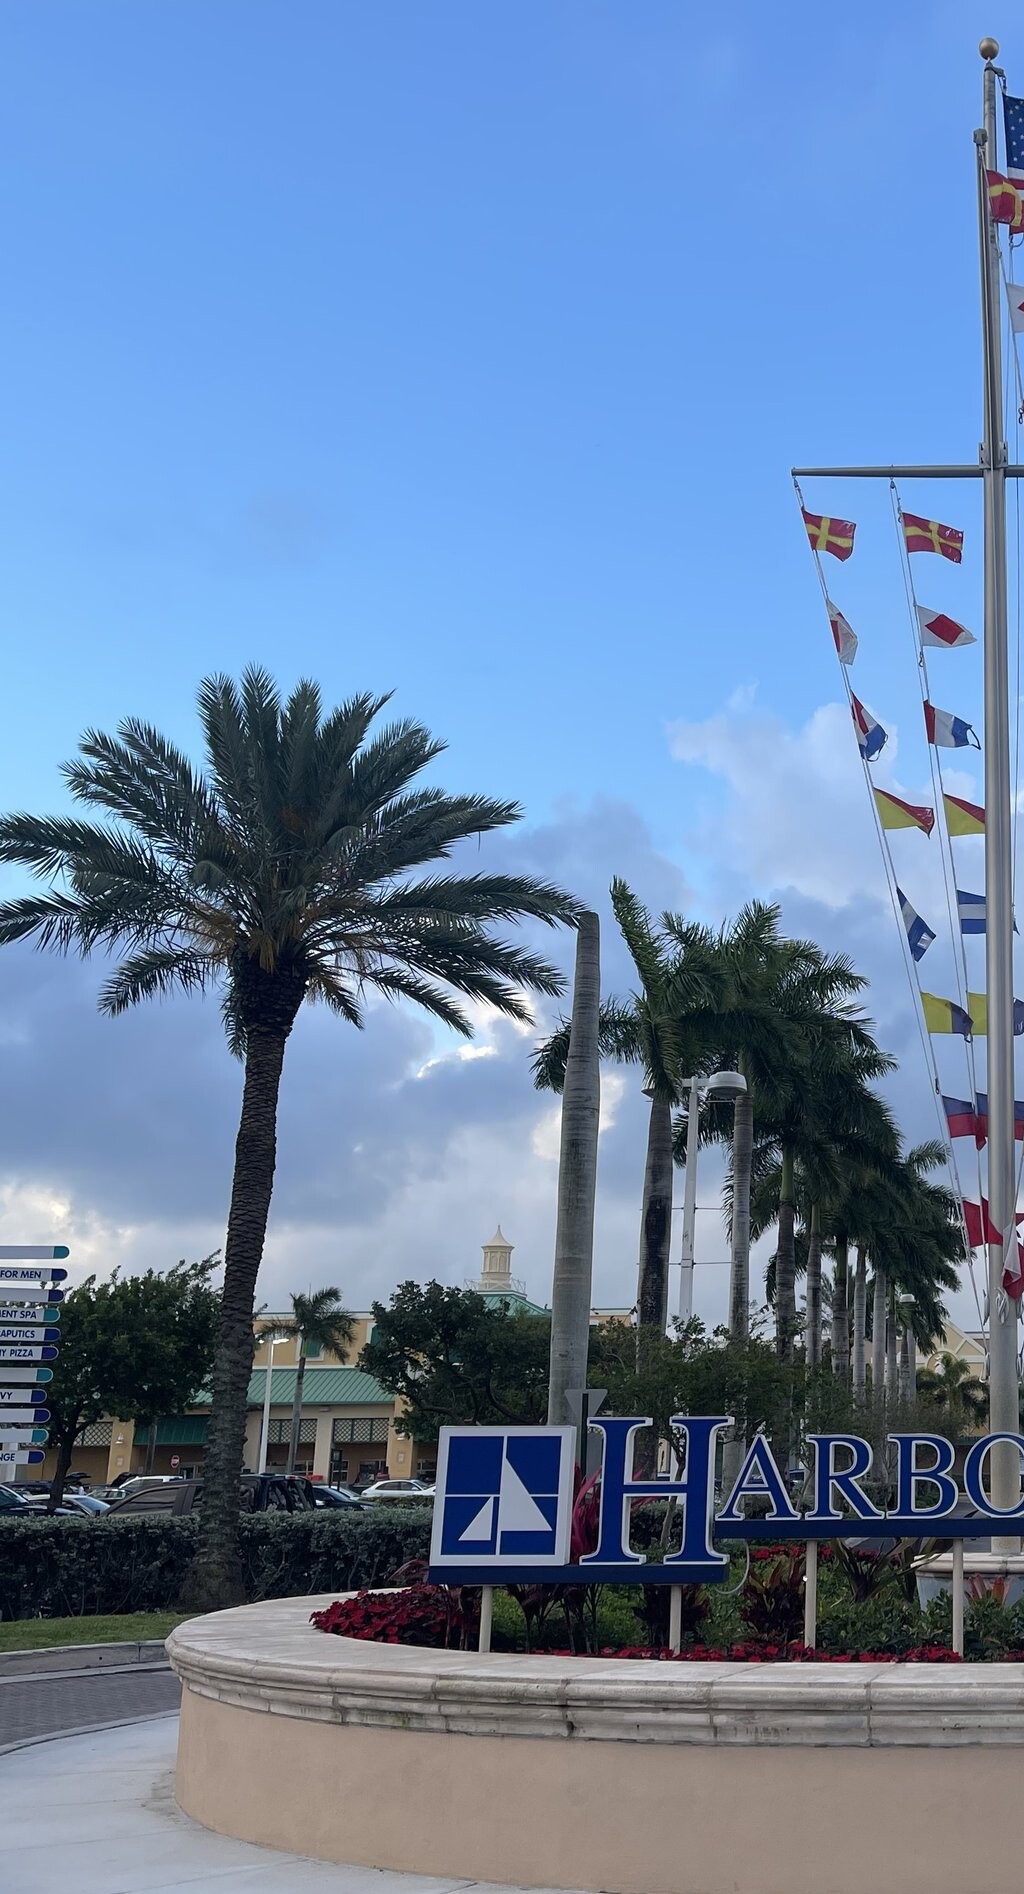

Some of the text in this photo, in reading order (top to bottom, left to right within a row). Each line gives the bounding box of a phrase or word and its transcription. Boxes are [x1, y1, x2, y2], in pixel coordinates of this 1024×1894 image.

[0, 1270, 42, 1279] FOR MEN
[0, 1309, 37, 1319] ENT SPA
[0, 1329, 36, 1338] APUTICS
[9, 1348, 34, 1358] PIZZA
